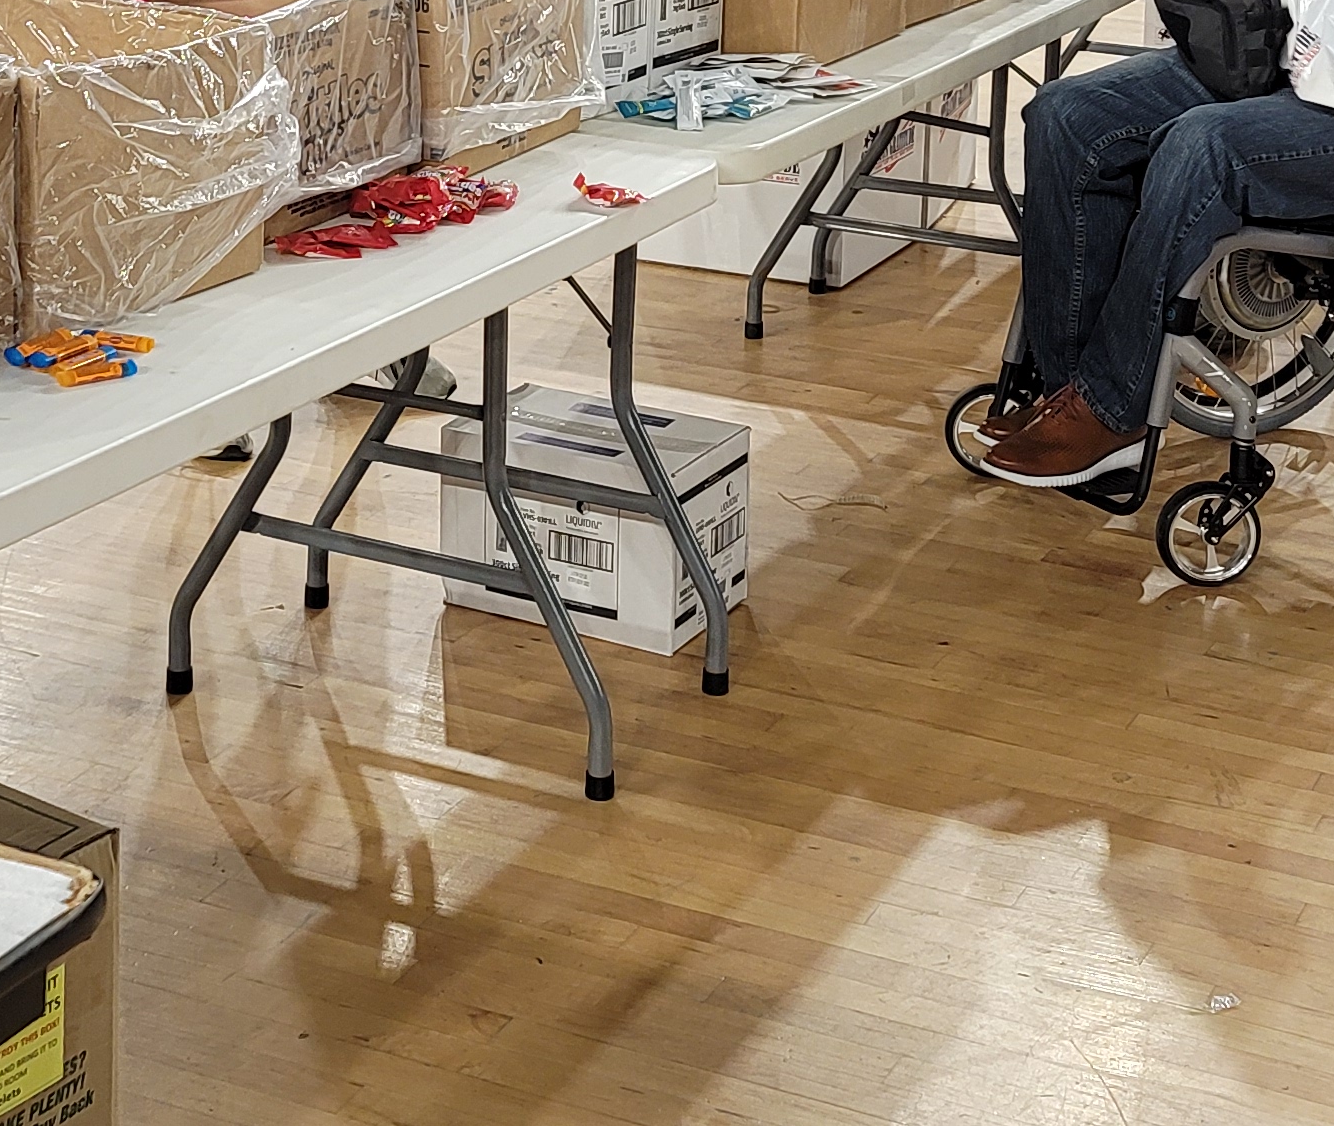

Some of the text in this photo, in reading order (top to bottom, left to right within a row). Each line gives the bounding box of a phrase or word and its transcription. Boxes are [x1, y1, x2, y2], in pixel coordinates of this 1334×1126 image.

[20, 1029, 39, 1047] THIS
[28, 1071, 87, 1122] PLENTY!
[59, 1089, 96, 1124] Back
